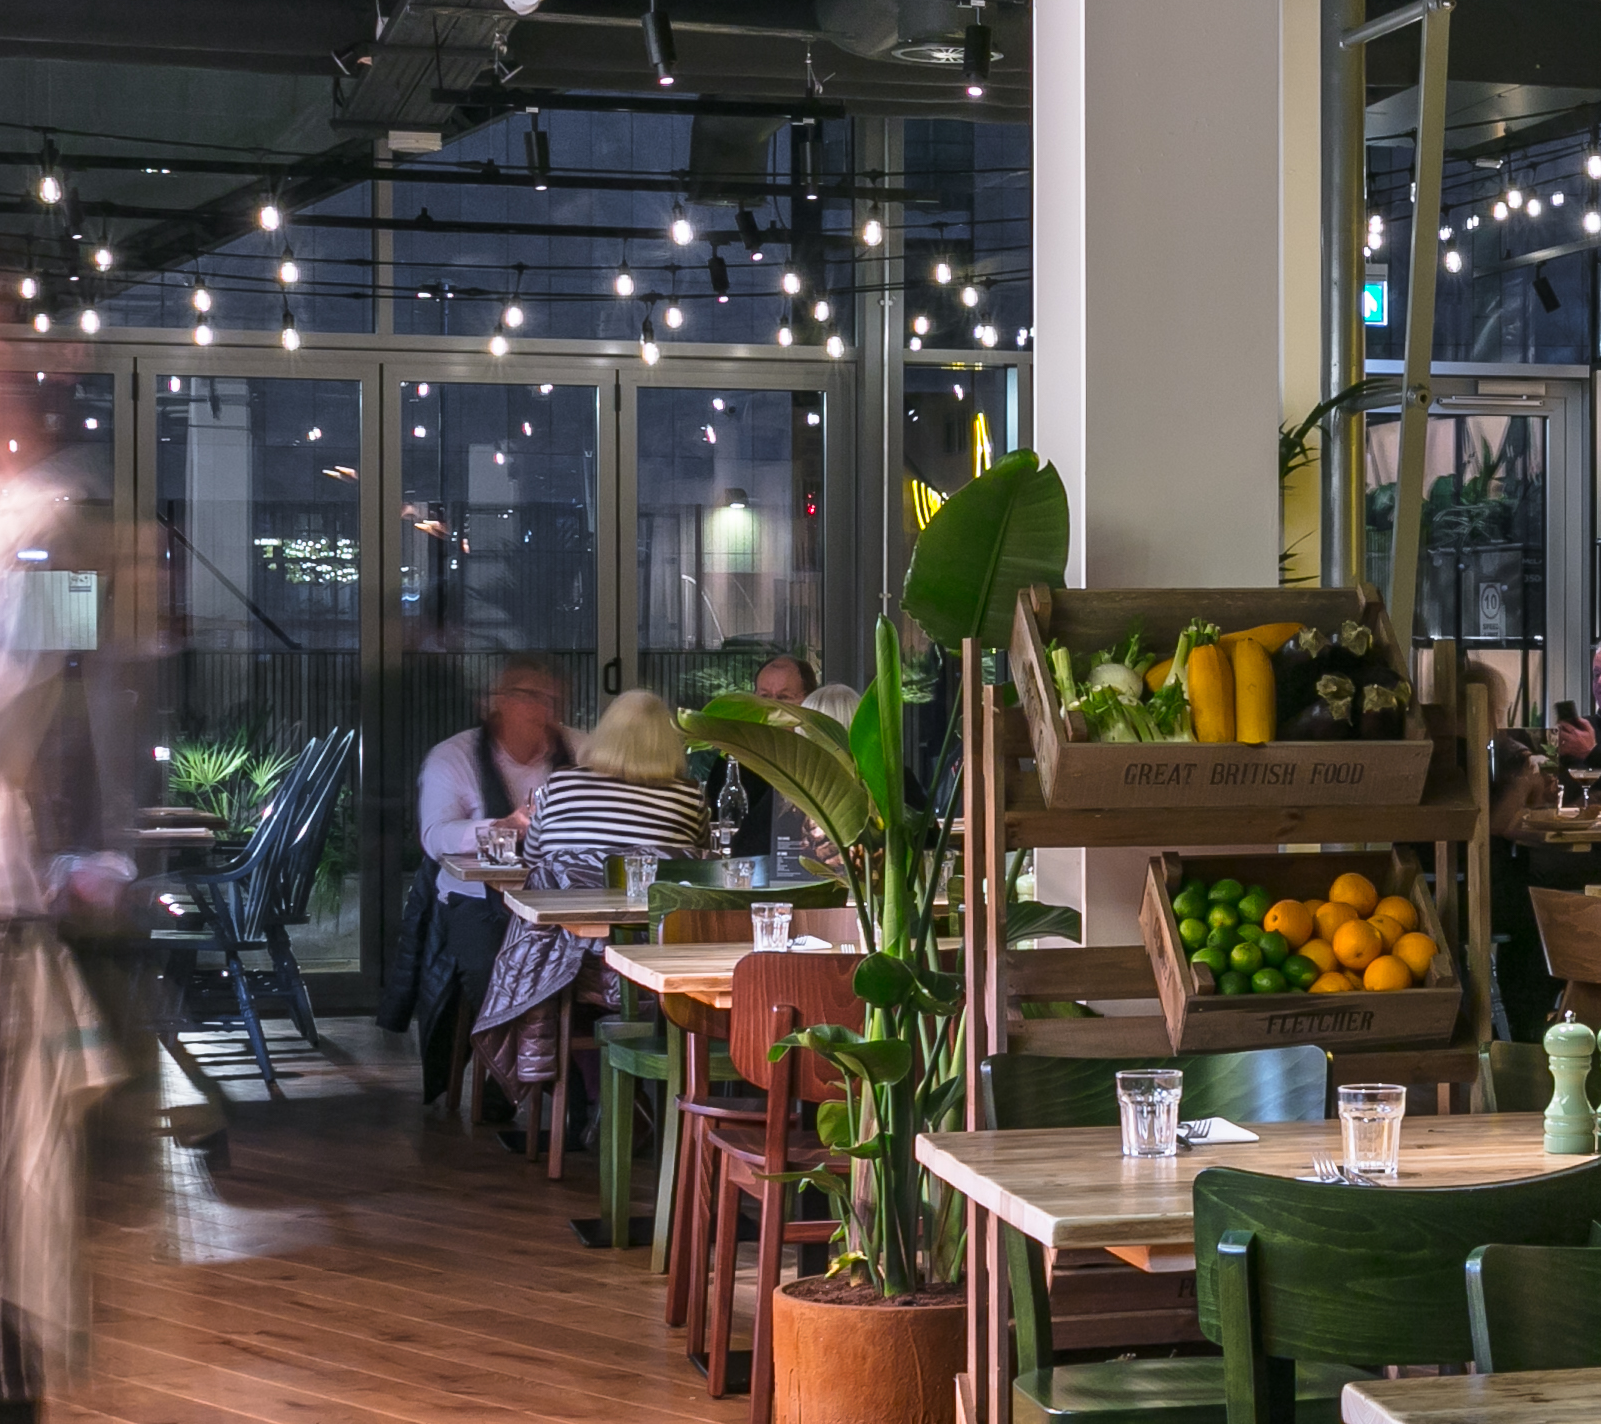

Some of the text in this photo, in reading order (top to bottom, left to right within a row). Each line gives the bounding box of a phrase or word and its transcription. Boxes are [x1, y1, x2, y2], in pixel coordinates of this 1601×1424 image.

[1484, 594, 1497, 610] 10
[1124, 763, 1365, 785] GREAT BRITISH FOOD
[1266, 1011, 1375, 1034] FLETCHER
